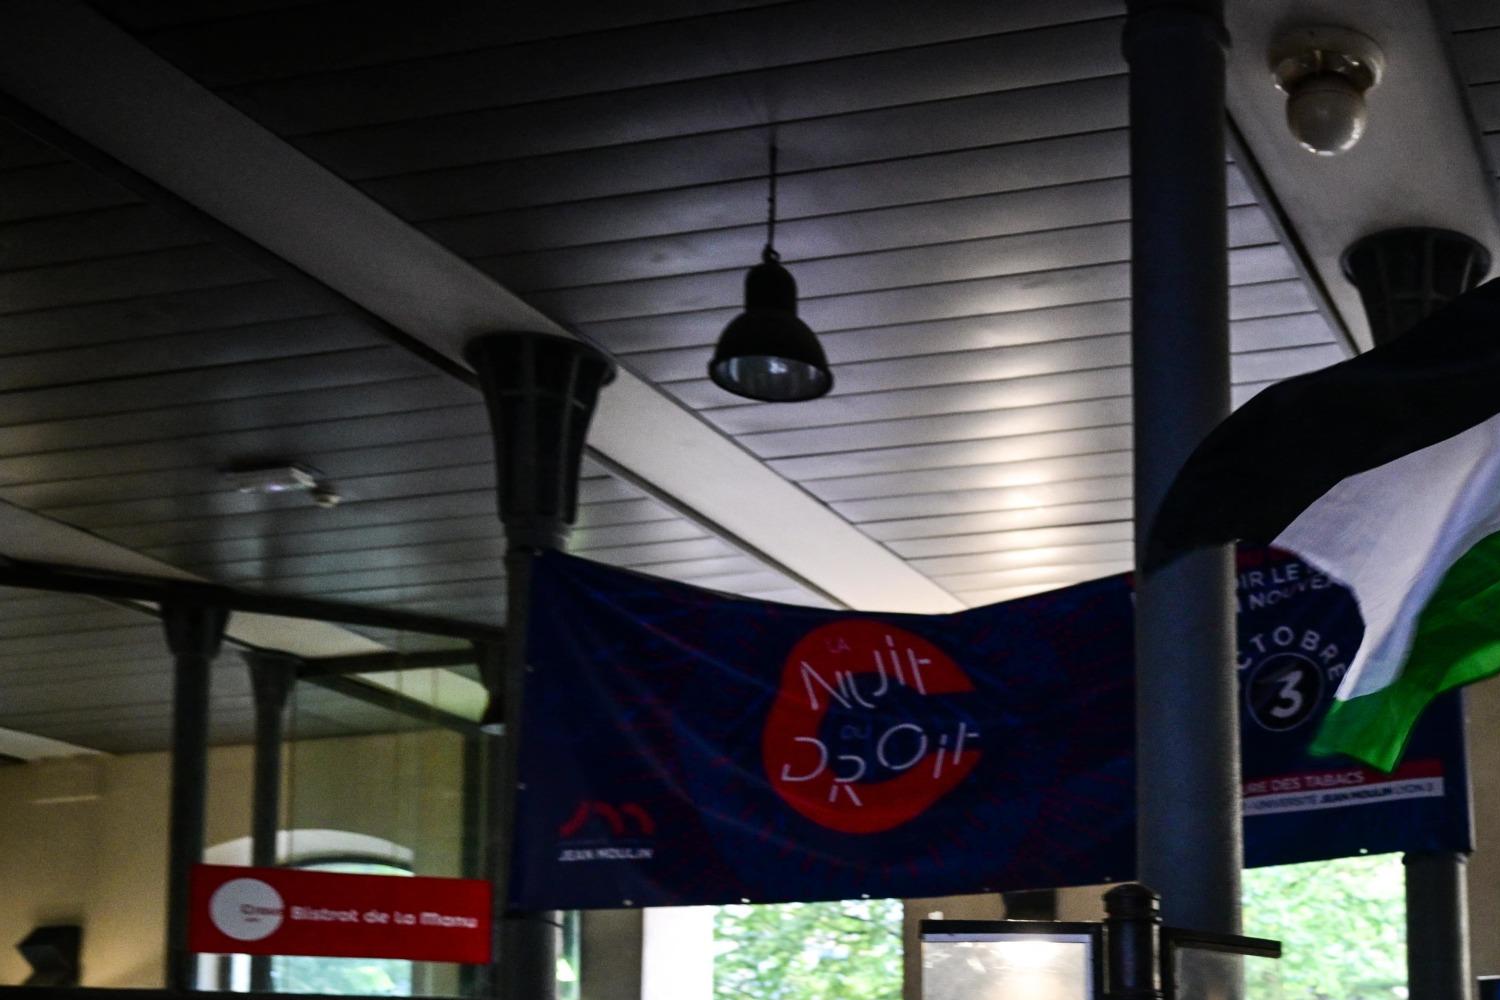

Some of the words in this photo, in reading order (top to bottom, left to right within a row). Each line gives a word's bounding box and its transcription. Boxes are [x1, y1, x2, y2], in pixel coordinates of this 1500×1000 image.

[1239, 571, 1265, 590] IR
[1269, 669, 1305, 719] 3
[289, 905, 359, 924] Bistrot
[362, 909, 390, 925] de
[419, 912, 479, 929] Manu
